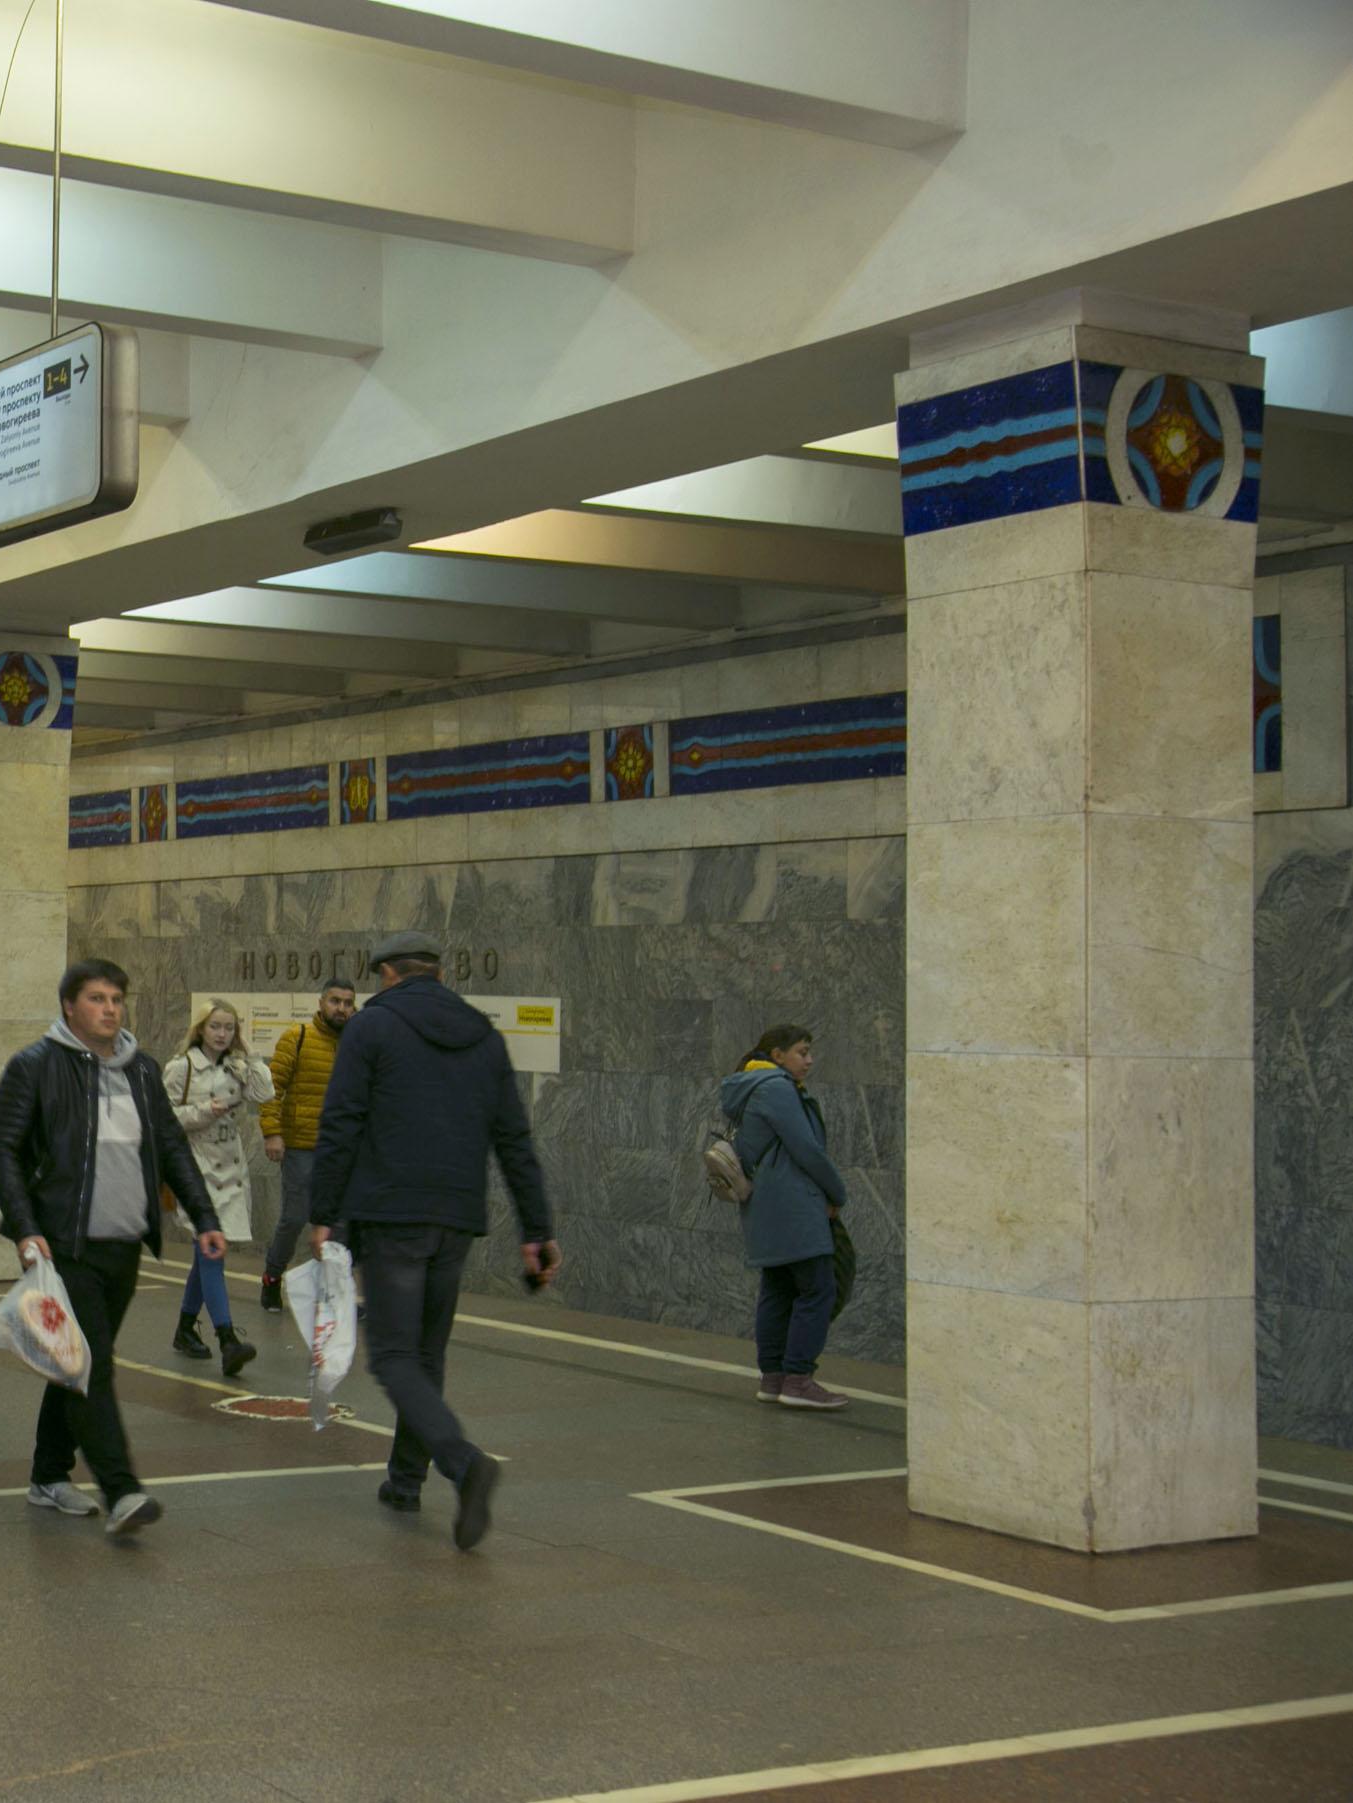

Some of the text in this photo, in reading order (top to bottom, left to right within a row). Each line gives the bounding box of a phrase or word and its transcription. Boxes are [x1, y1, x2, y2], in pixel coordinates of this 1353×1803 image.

[7, 374, 41, 397] проспект
[47, 367, 68, 391] 1-4
[2, 391, 41, 413] проспекту
[242, 948, 498, 981] НОВОГИВО
